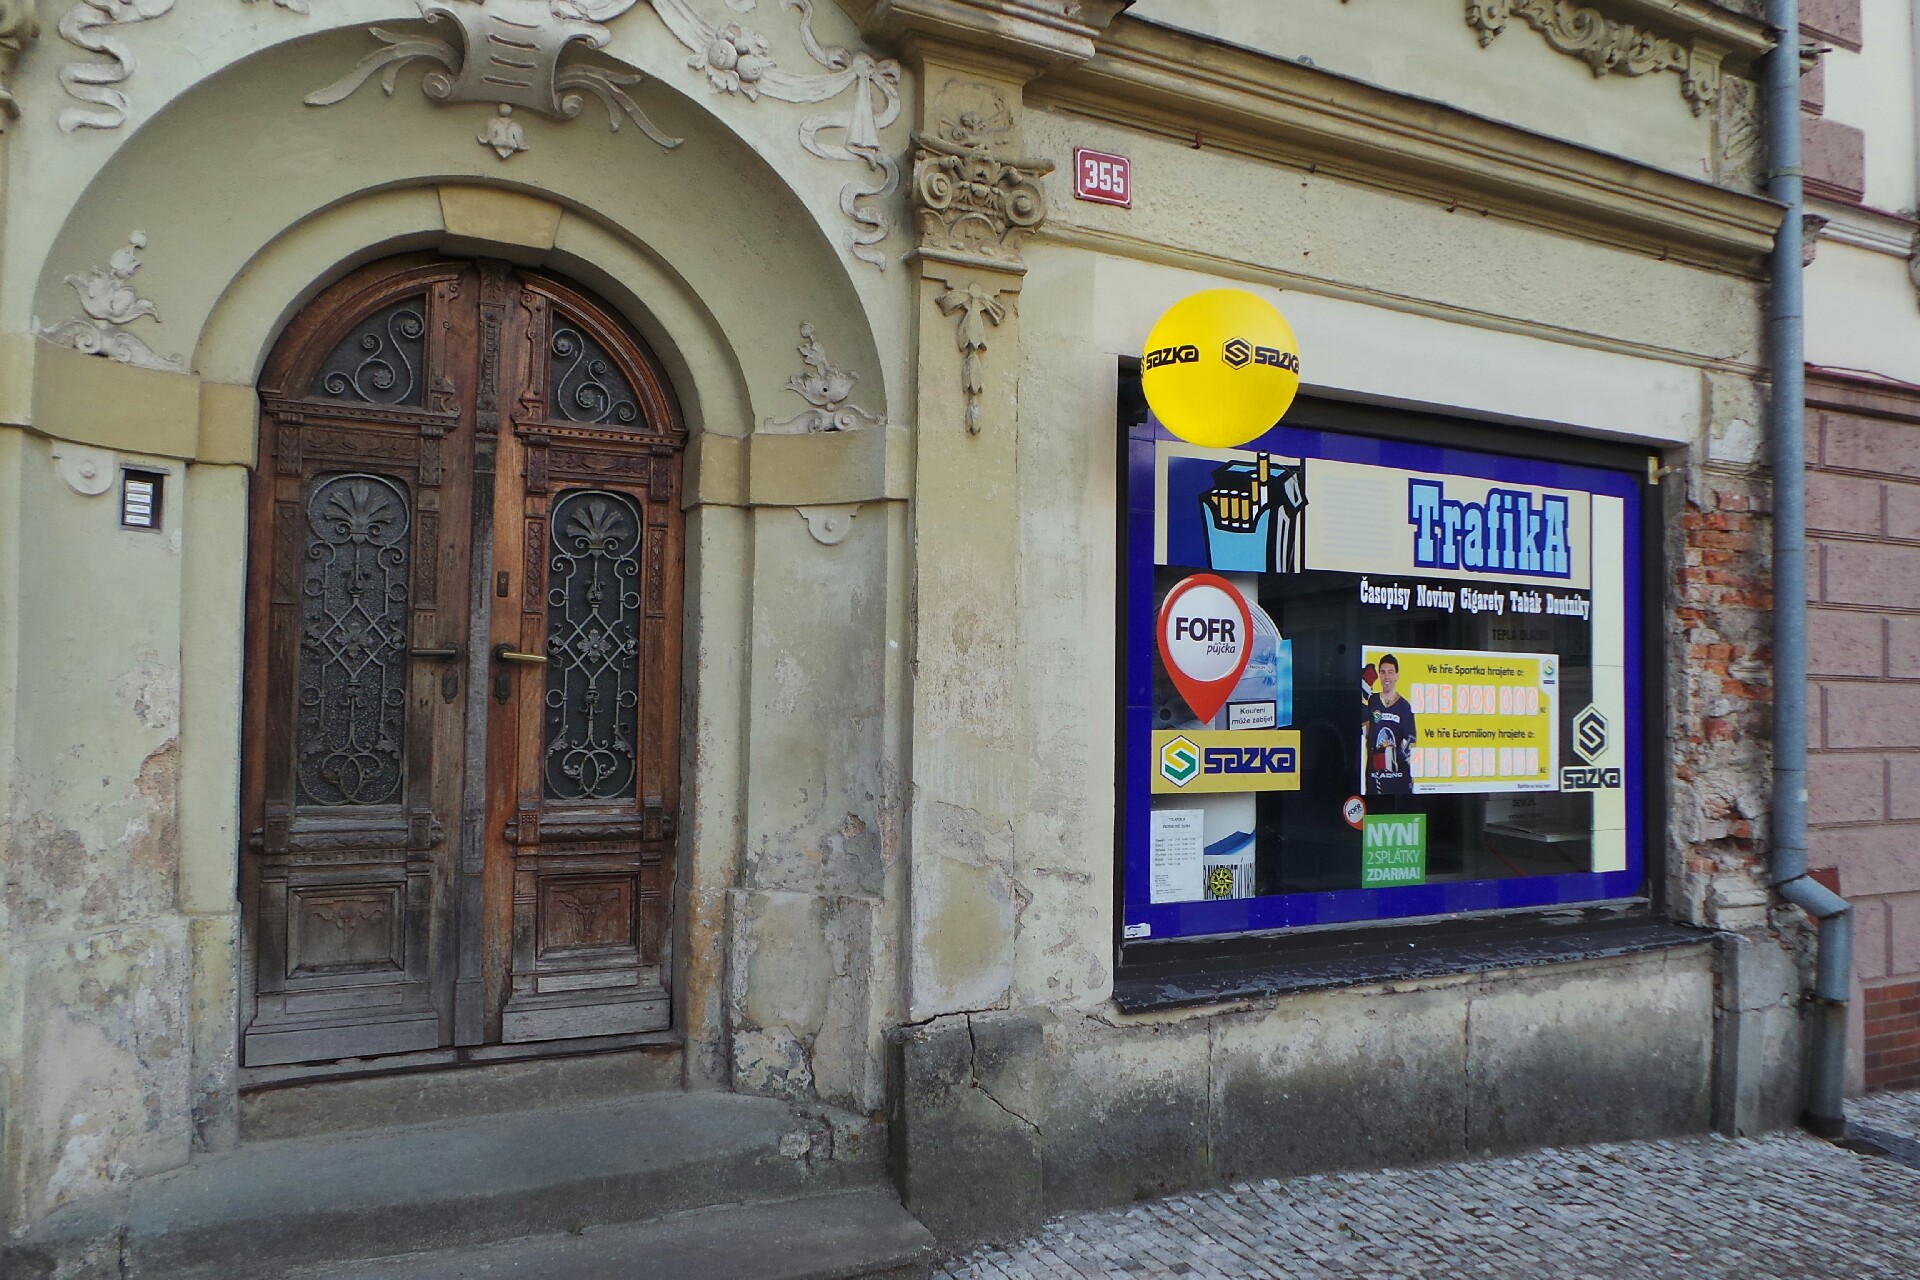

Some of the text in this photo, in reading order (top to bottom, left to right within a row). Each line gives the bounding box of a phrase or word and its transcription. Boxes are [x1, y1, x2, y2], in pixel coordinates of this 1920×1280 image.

[1085, 159, 1124, 194] 355
[1408, 477, 1571, 579] TrafikA
[1360, 576, 1590, 620] Časopisy Noviny Cigarety Tabák Doutníky
[1175, 616, 1236, 643] FOFR
[1426, 664, 1438, 674] Ve
[1454, 664, 1486, 677] Sportka
[1487, 666, 1515, 678] hrajete
[1424, 728, 1435, 738] Ve
[1452, 728, 1496, 740] Euromiliony
[1498, 729, 1526, 740] hrajete
[1347, 803, 1362, 818] FOFR
[1367, 817, 1421, 848] NYNÍ
[1366, 848, 1421, 865] 2 SPLÁTKY
[1366, 866, 1421, 882] ZDARMA!
